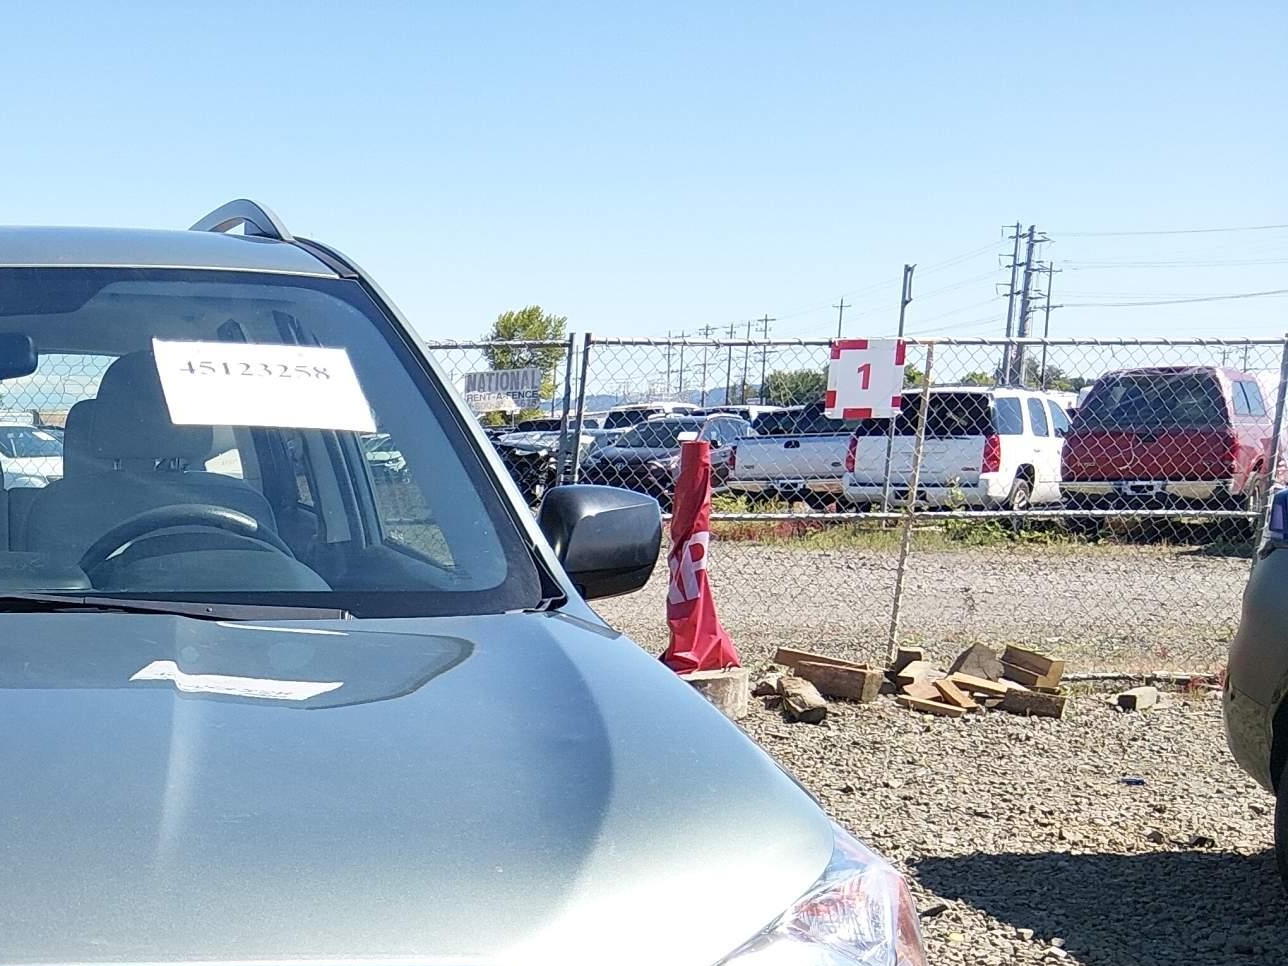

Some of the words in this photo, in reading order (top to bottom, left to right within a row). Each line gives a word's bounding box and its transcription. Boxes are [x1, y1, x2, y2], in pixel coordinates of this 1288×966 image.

[179, 360, 331, 380] 45123258
[466, 369, 539, 394] NATIONAL
[857, 363, 871, 390] 1
